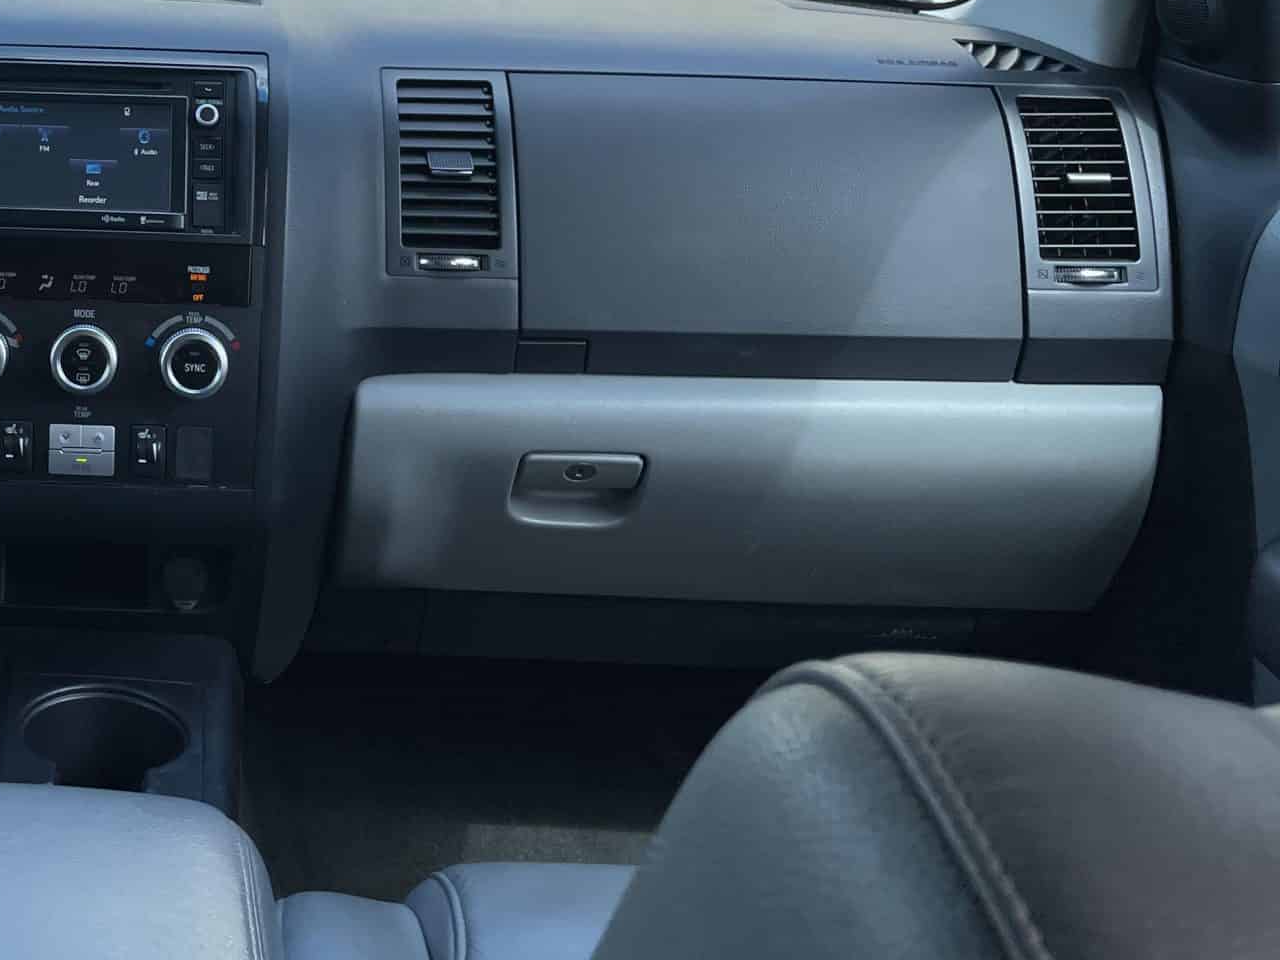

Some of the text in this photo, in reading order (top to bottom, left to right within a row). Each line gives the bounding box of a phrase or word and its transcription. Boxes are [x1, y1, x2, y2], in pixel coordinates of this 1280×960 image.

[140, 148, 158, 156] Audio
[74, 309, 96, 318] MODE
[184, 363, 206, 373] SYNC
[74, 411, 92, 419] TEMP
